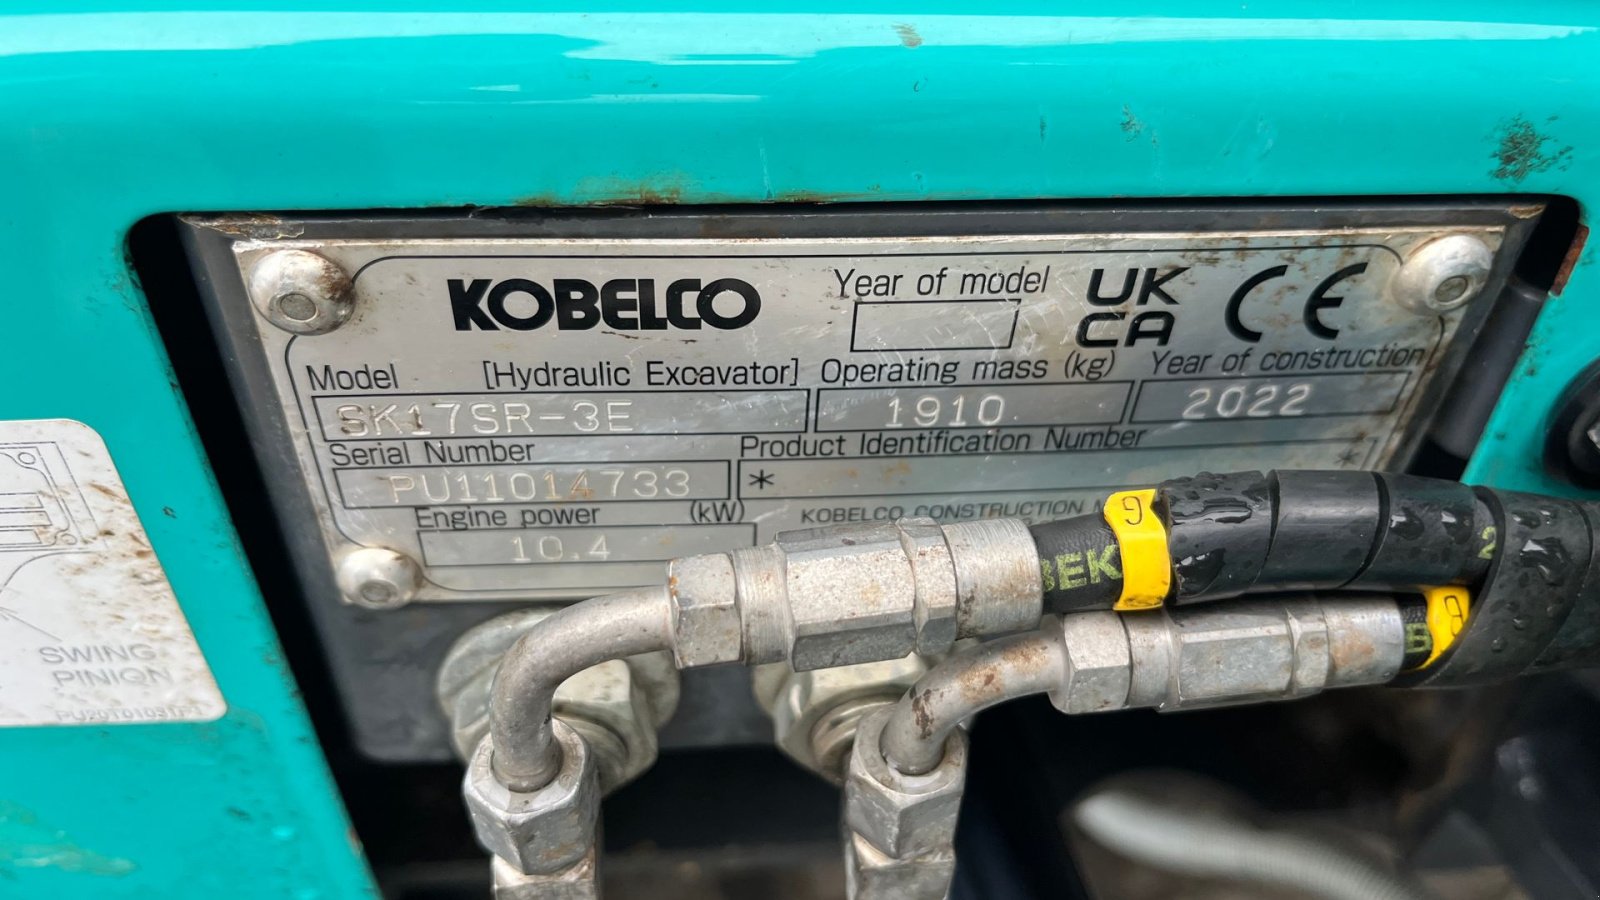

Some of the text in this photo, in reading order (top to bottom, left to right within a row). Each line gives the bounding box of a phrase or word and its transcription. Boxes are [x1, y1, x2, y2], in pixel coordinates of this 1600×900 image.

[833, 264, 1051, 298] Year of model
[1085, 266, 1191, 307] UK
[447, 277, 761, 331] KOBELCO
[1074, 311, 1177, 348] CA
[306, 356, 799, 391] Model [Hydraulic Excavator]
[821, 349, 1116, 387] Operating mass (kg)
[1150, 345, 1426, 376] Year of construction
[335, 399, 635, 438] SK17SR-3E
[885, 394, 1006, 429] 1910
[1181, 383, 1312, 420] 2022
[330, 438, 536, 468] Serial Number
[740, 425, 1148, 458] Product Identification Number
[384, 468, 692, 503] PU11014733
[414, 498, 746, 531] Engine power (kW)
[801, 505, 905, 525] KOBELCO
[914, 498, 1084, 520] CONSTRUCTION
[511, 534, 611, 562] 10.4
[38, 643, 159, 666] SWING
[52, 666, 176, 688] PINION
